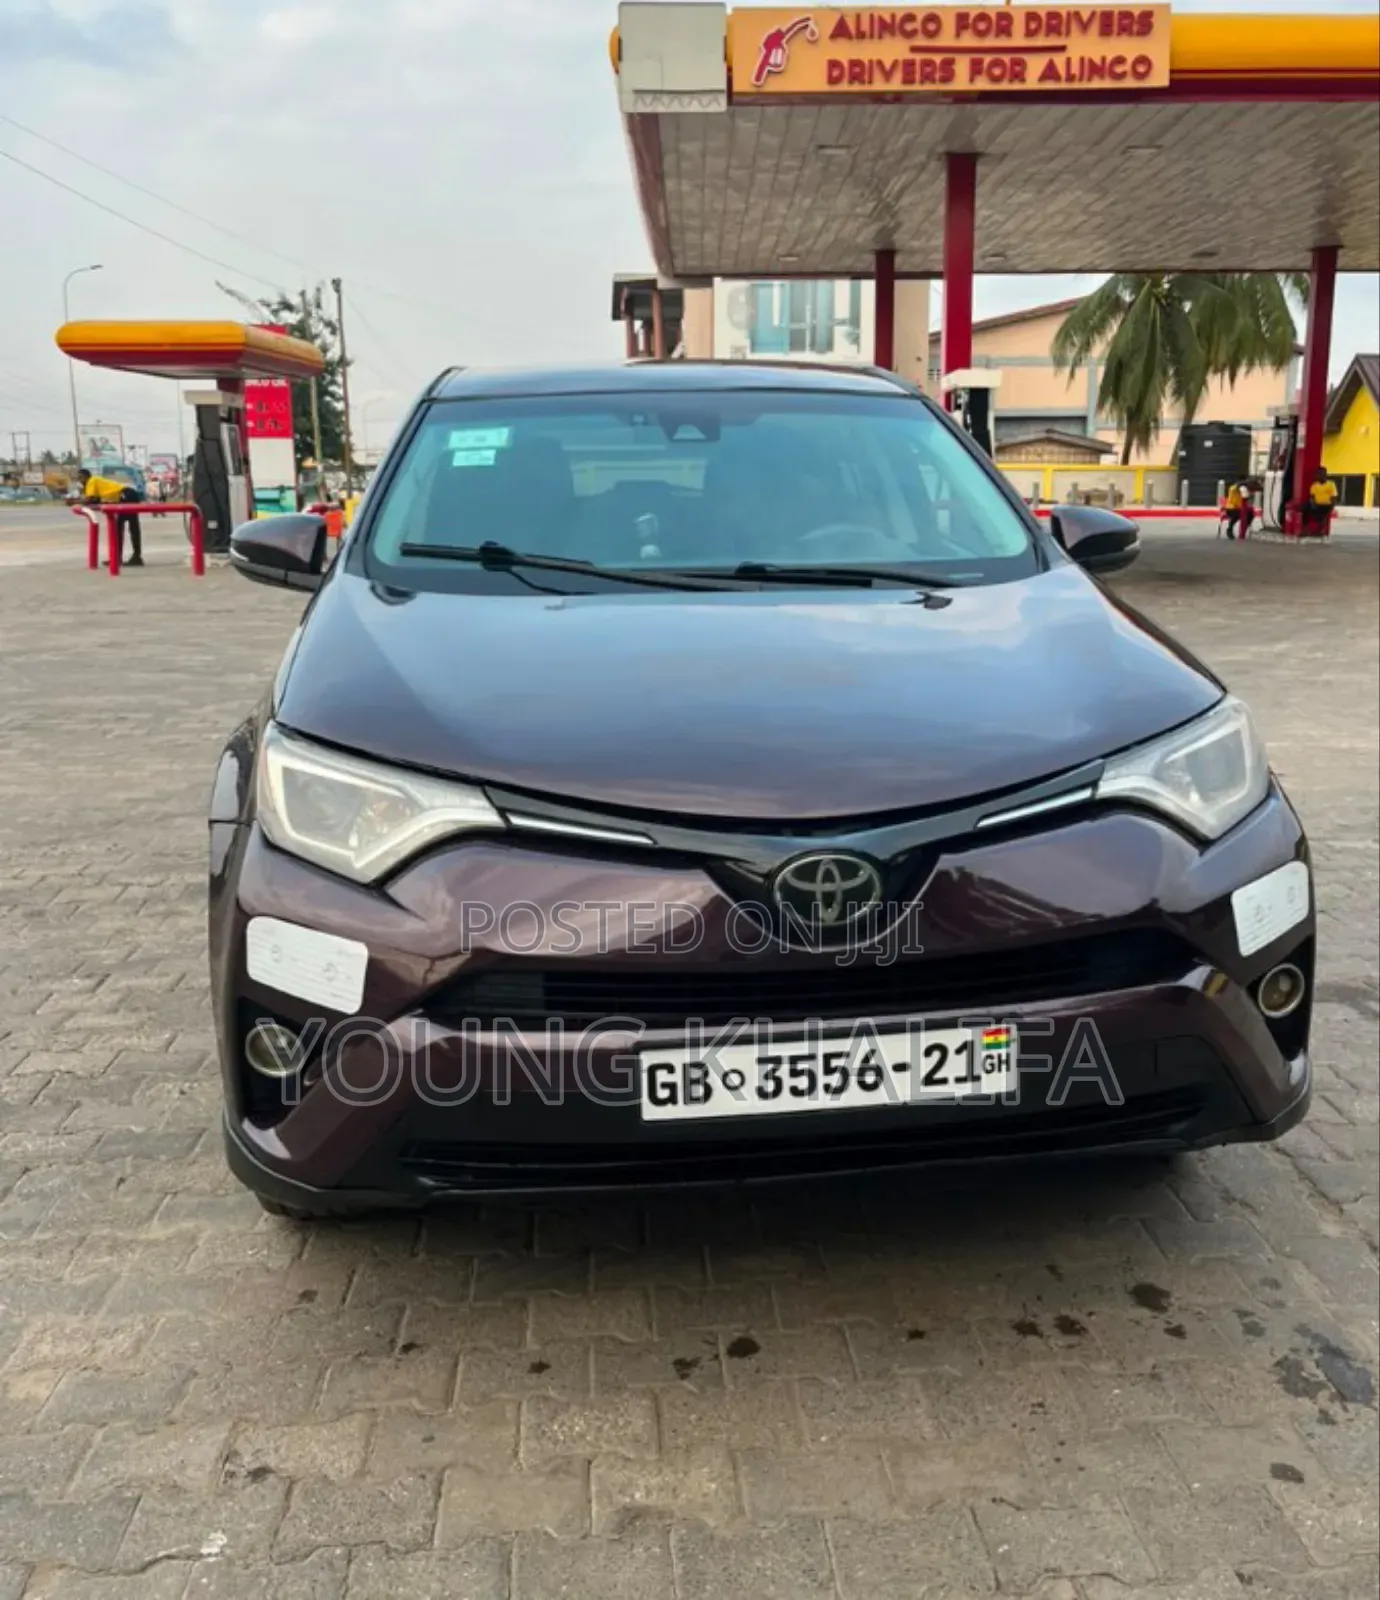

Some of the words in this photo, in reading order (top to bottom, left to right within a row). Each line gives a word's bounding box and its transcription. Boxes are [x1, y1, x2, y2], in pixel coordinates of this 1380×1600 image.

[829, 12, 942, 40] ALINCO
[954, 11, 1013, 39] FOR
[1023, 10, 1154, 37] DRIVERS
[826, 57, 956, 85] DRIVERS
[969, 56, 1027, 83] FOR
[1037, 54, 1153, 83] ALINCO
[981, 1053, 1011, 1076] GH
[646, 1062, 713, 1107] GB
